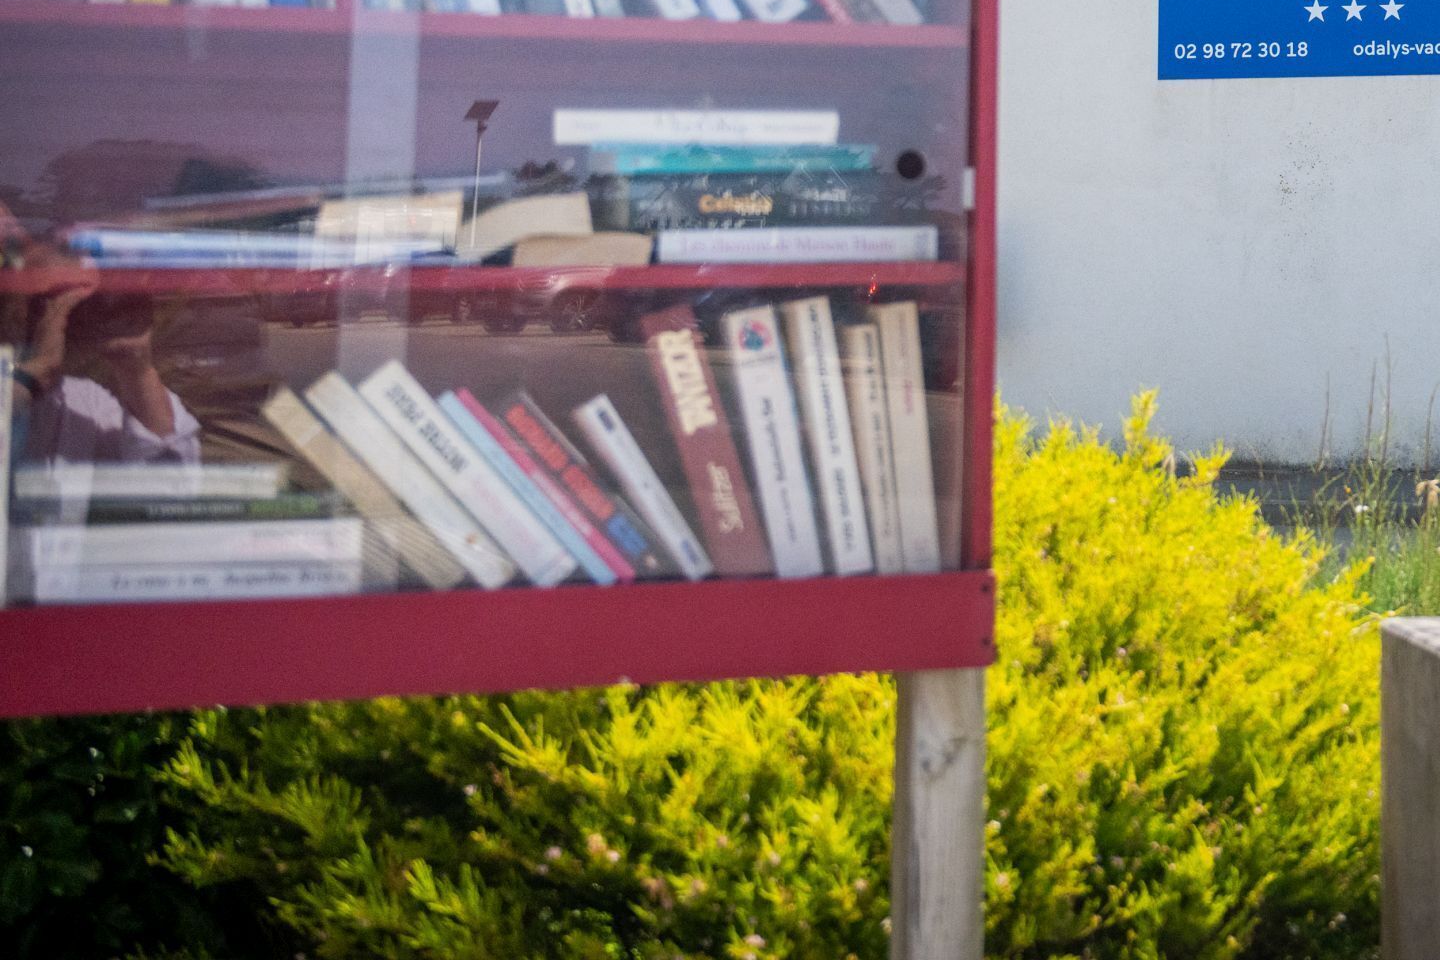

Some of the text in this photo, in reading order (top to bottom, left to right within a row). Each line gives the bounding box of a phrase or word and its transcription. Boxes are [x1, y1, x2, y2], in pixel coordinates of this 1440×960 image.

[1174, 42, 1308, 59] 02 98 72 30 18
